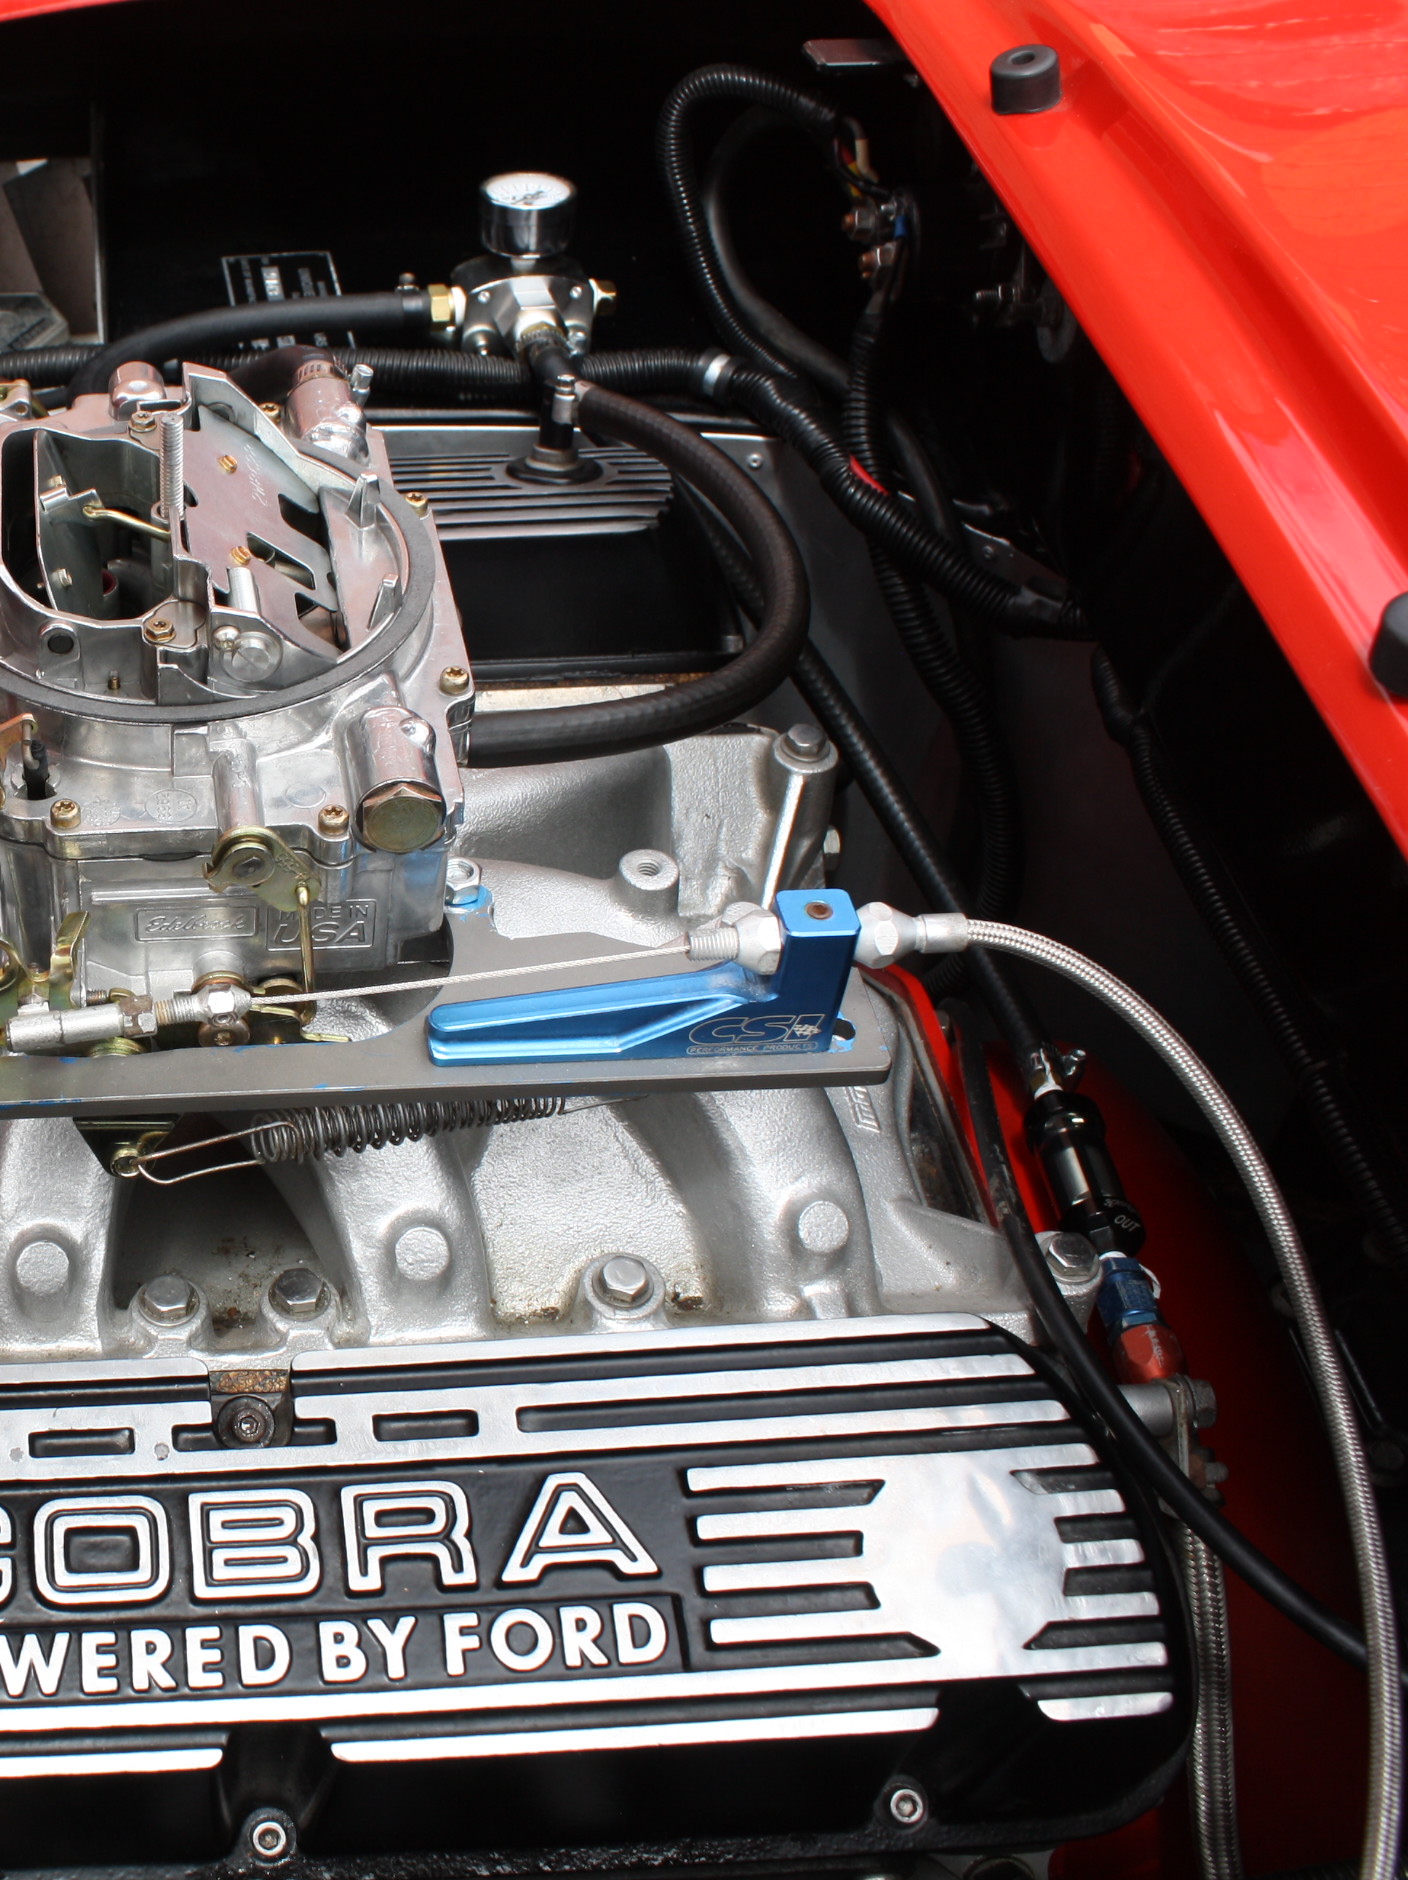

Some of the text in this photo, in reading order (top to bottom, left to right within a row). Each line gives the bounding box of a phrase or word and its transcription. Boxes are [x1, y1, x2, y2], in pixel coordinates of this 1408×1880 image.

[279, 904, 369, 921] MDE IN
[274, 920, 366, 946] USA
[689, 1013, 826, 1046] CSI
[1113, 1213, 1141, 1233] OUT
[320, 1615, 418, 1685] BY
[440, 1602, 668, 1678] FORD
